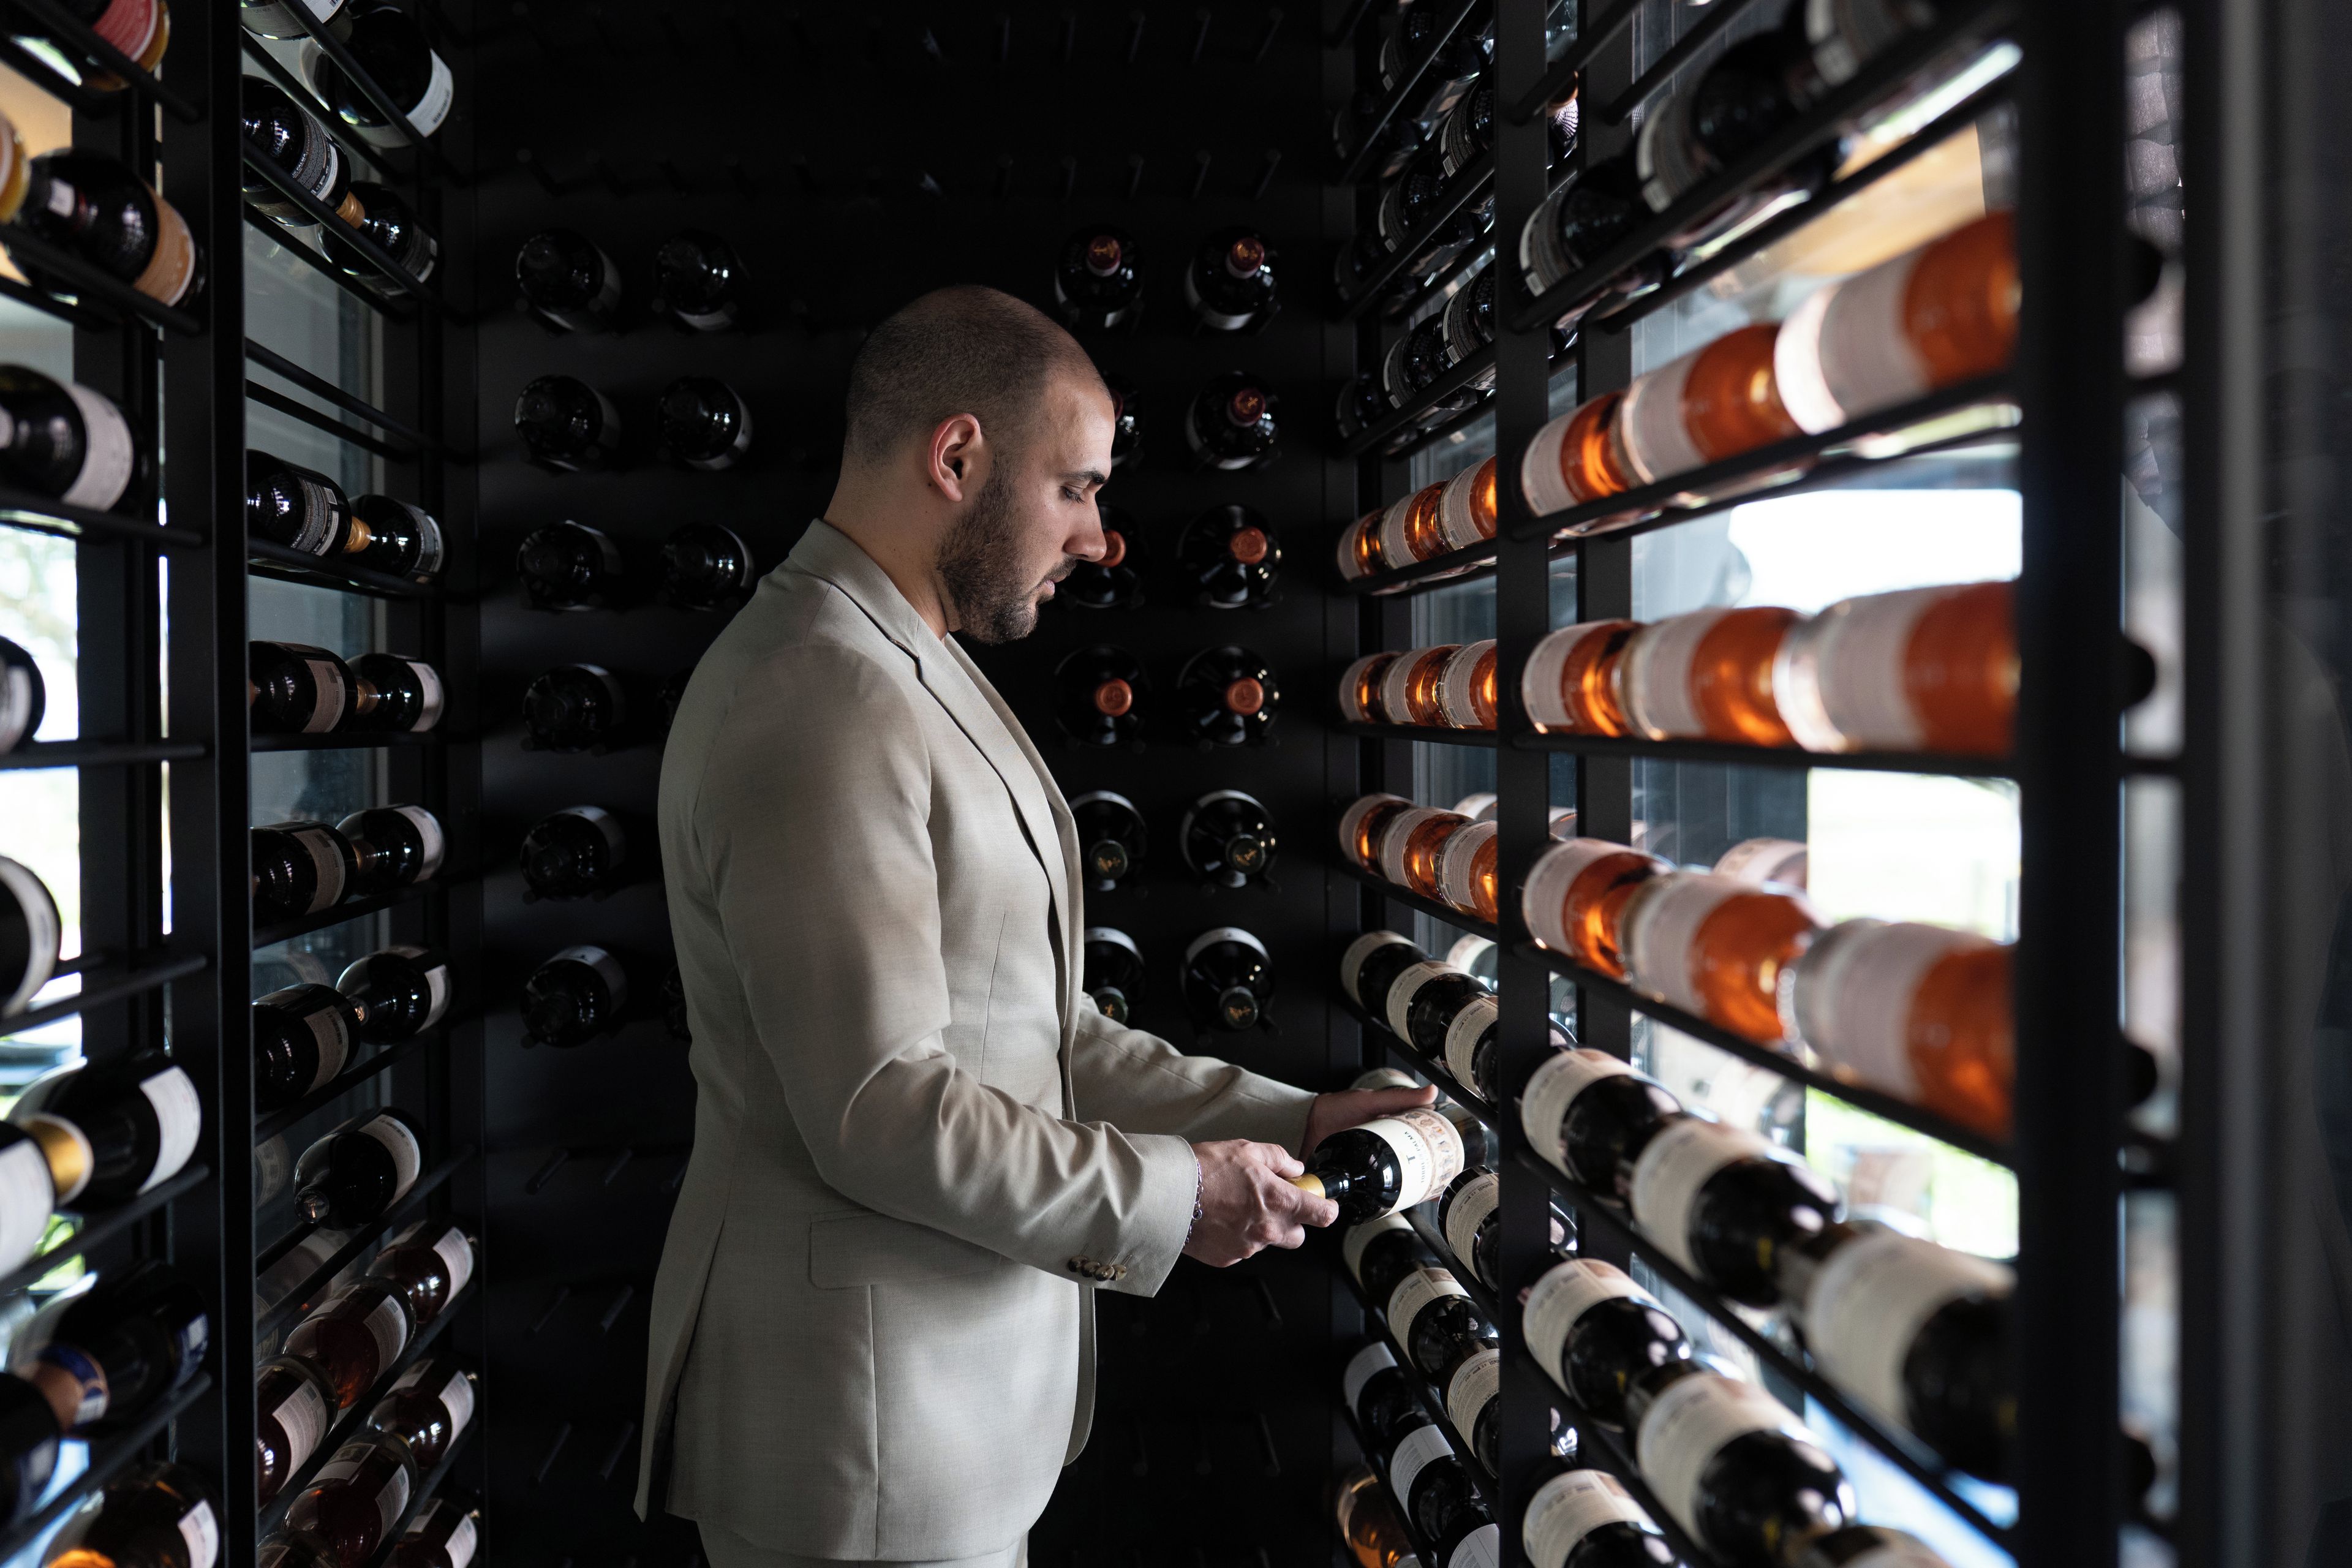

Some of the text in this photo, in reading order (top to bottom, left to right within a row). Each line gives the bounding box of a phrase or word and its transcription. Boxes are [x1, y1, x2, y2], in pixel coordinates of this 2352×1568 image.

[296, 154, 306, 171] PALMA
[1404, 1131, 1420, 1152] PALMA
[1406, 1155, 1415, 1165] T
